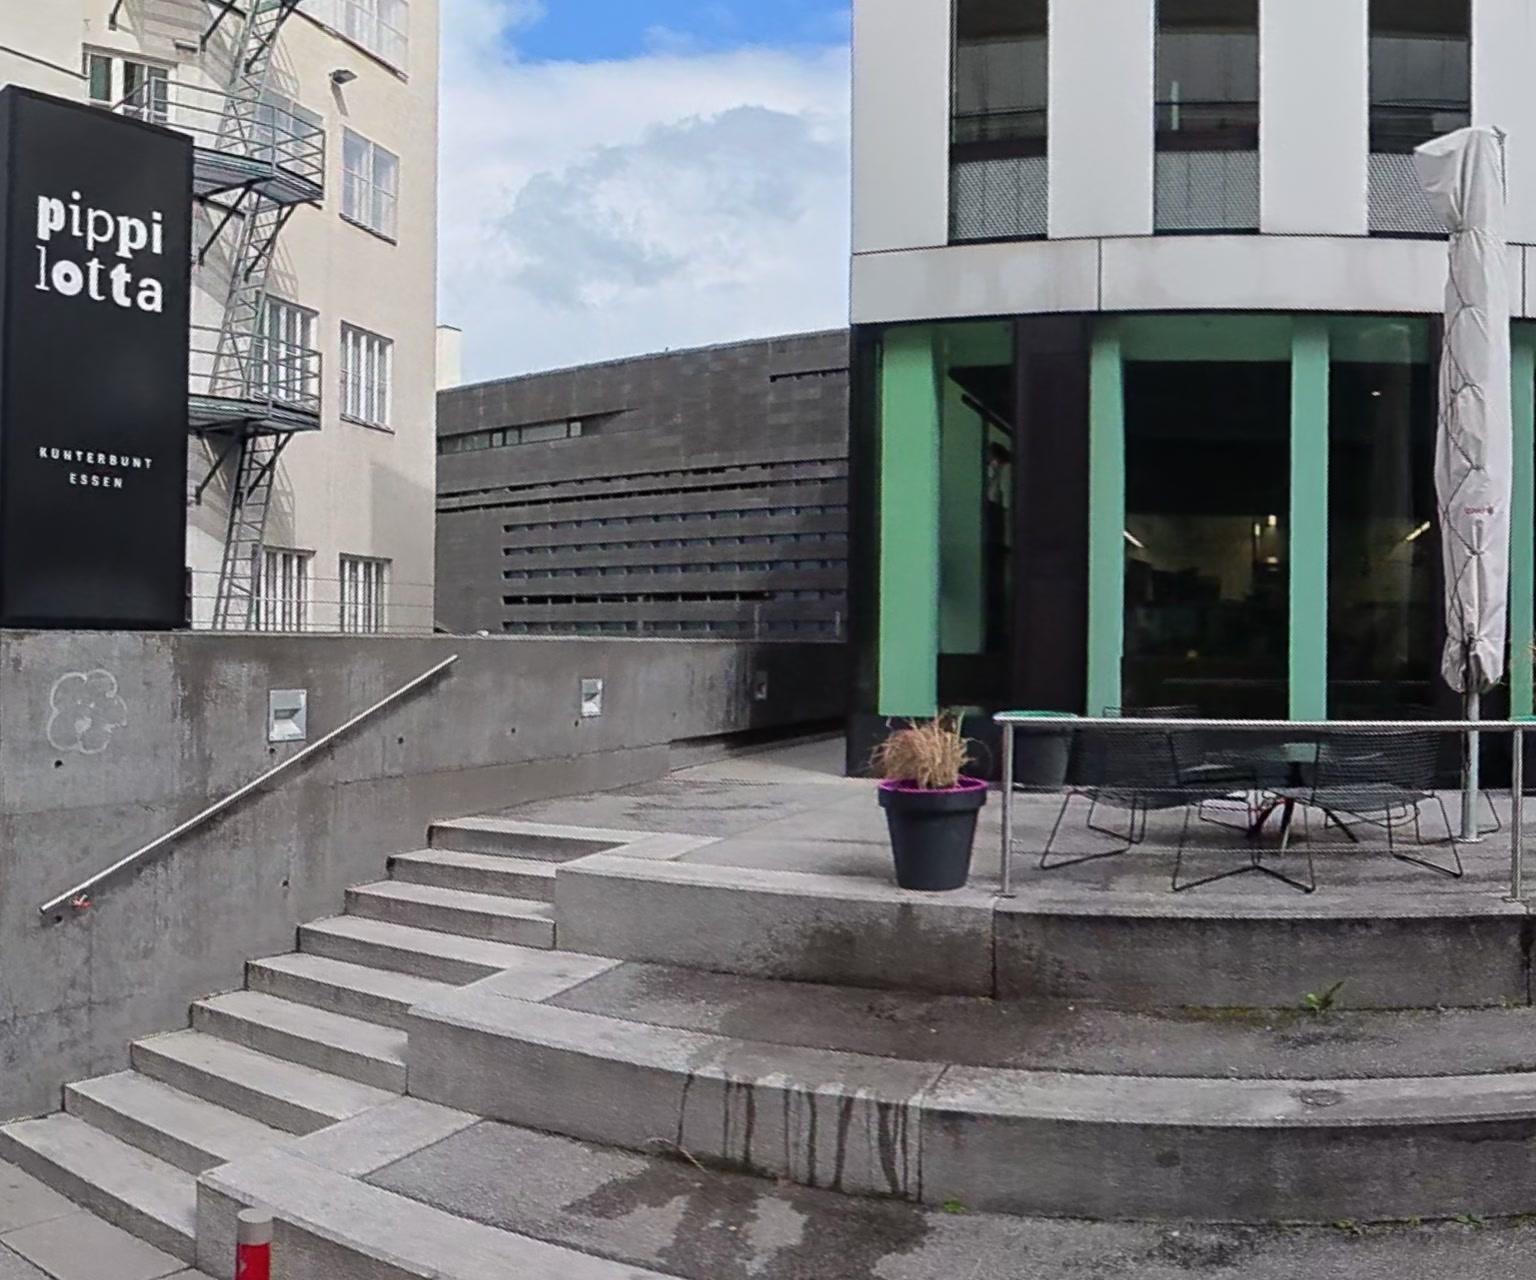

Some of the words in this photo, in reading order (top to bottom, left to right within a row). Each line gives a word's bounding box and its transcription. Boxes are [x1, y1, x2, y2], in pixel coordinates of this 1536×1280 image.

[37, 190, 162, 259] pippi
[35, 244, 162, 312] lotta
[39, 446, 152, 469] KUNTERBUNT
[69, 472, 122, 488] ESSEN
